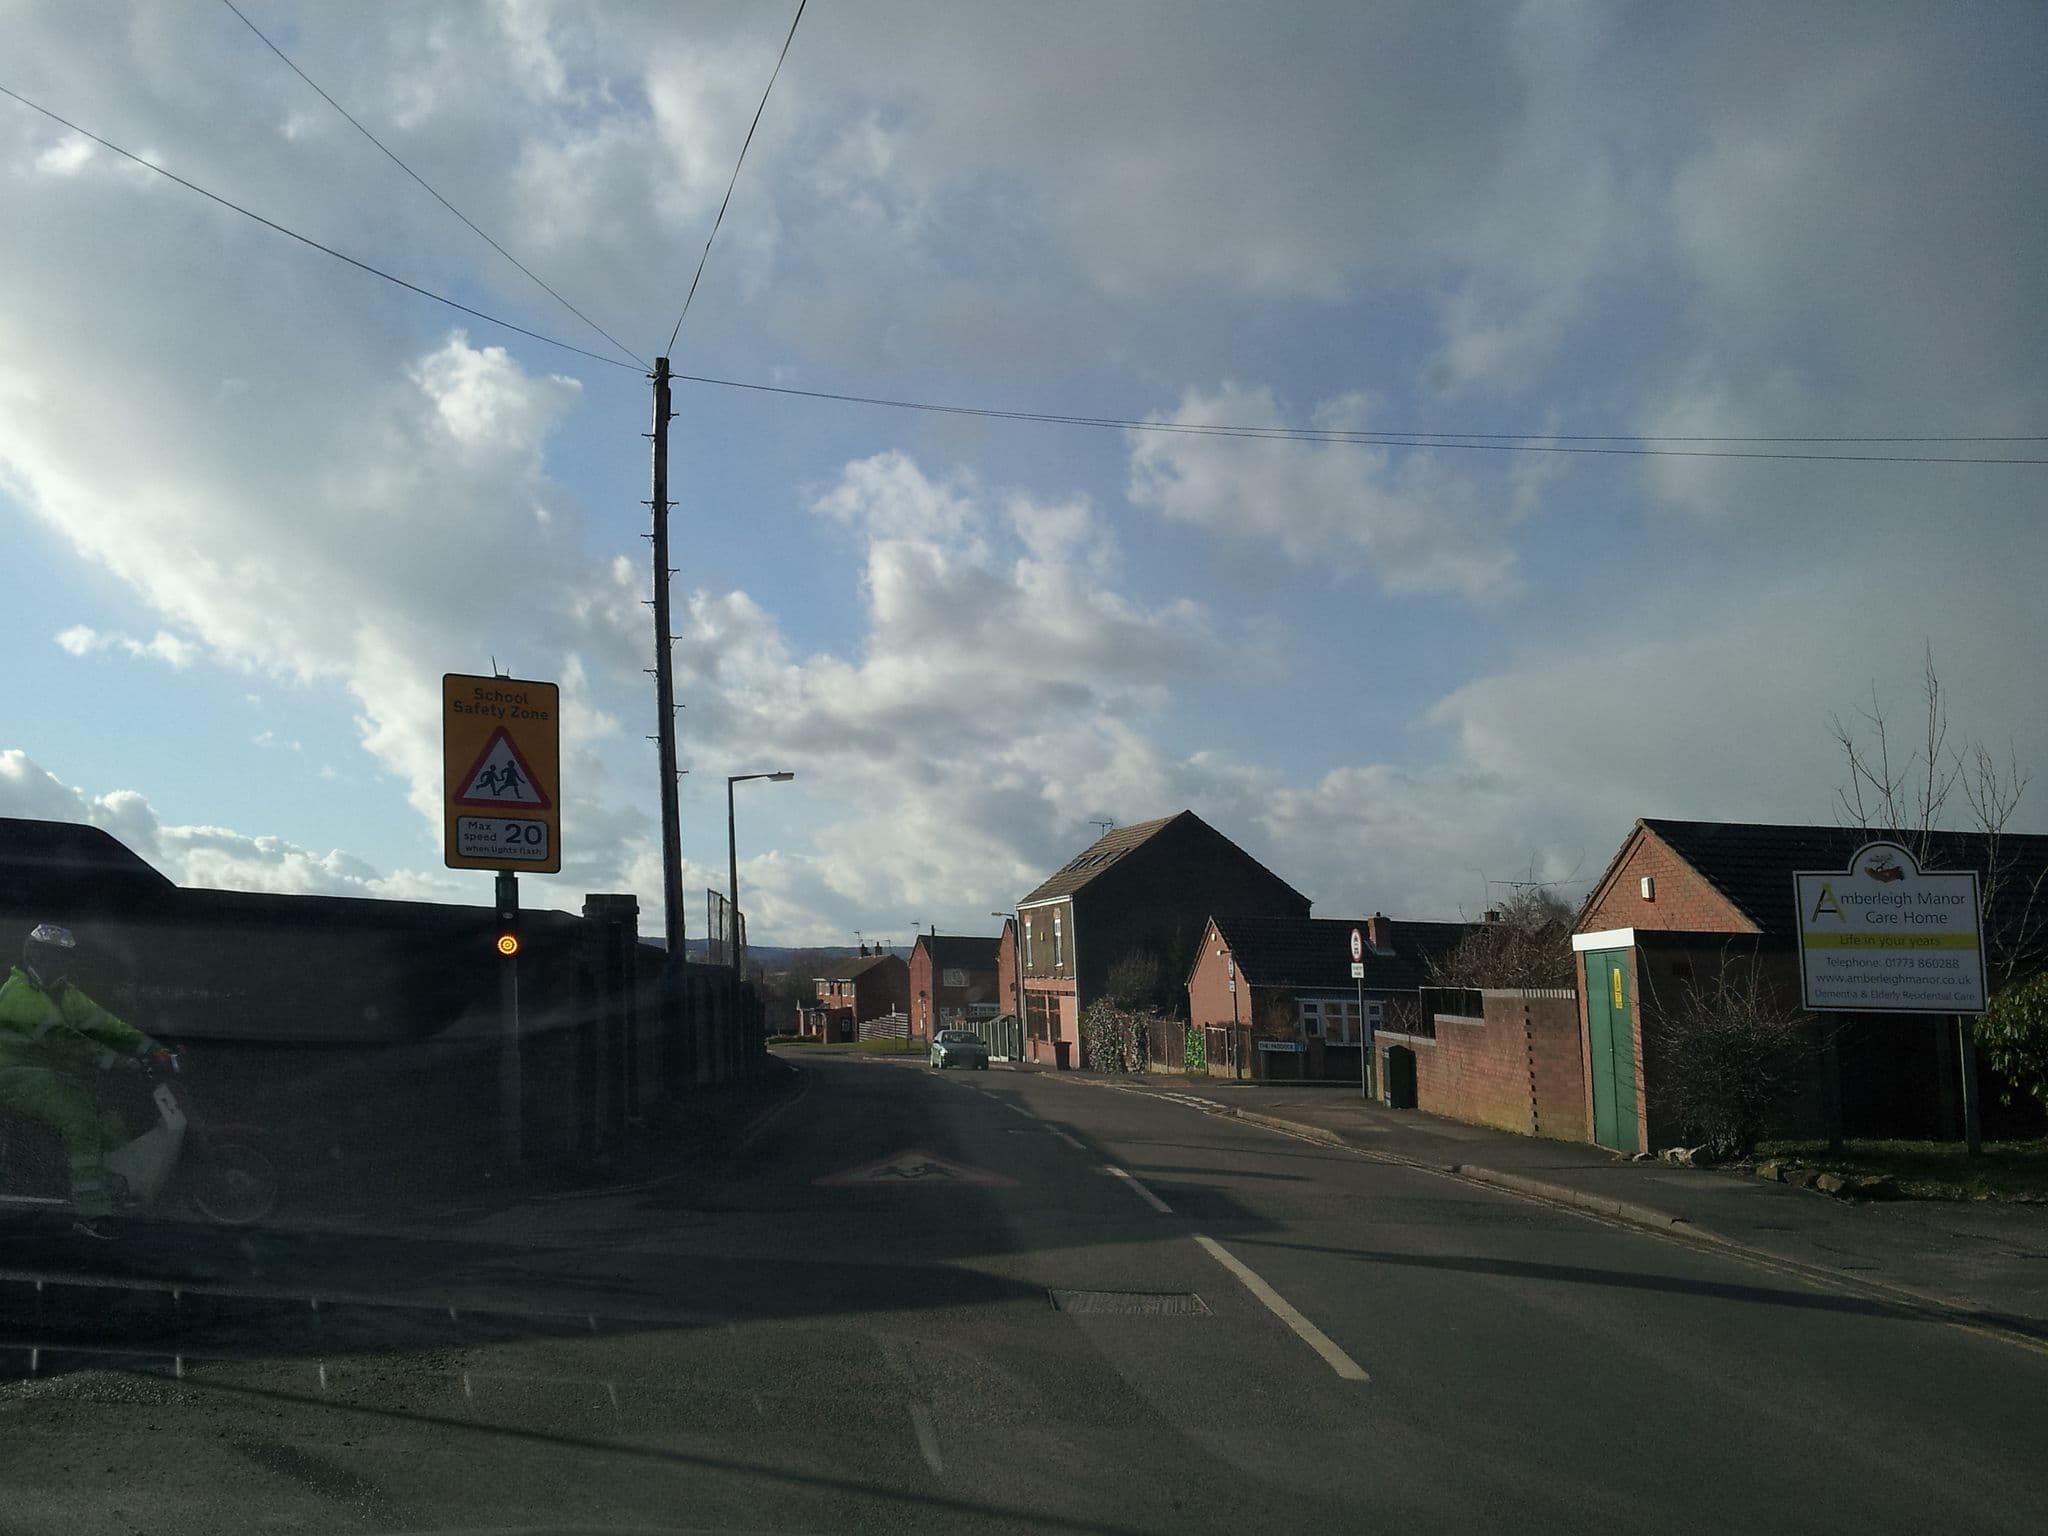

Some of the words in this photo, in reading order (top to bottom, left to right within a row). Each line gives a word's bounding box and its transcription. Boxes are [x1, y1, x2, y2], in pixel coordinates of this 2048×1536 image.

[474, 687, 529, 704] School
[453, 700, 505, 719] Safety
[511, 705, 549, 720] Zone
[468, 821, 492, 831] Max
[464, 832, 497, 842] speed
[505, 823, 543, 845] 20
[465, 845, 490, 853] when
[491, 846, 517, 855] lights
[1811, 882, 1913, 923] Amberleigh
[1918, 893, 1966, 905] Manor
[1866, 911, 1898, 924] Care
[1904, 912, 1949, 925] Home
[1840, 935, 1861, 946] Life
[1864, 935, 1876, 945] in
[1879, 937, 1906, 948] your
[1910, 937, 1941, 948] years
[1885, 958, 1914, 968] 01773
[1918, 958, 1960, 969] 860288
[1815, 972, 1972, 986] www.amberleighmanor.co.uk
[1814, 989, 1858, 999] Dementia
[1861, 990, 1868, 999] &
[1870, 990, 1899, 1001] Elderly
[1903, 991, 1951, 1001] Residential
[1954, 991, 1976, 1001] Care
